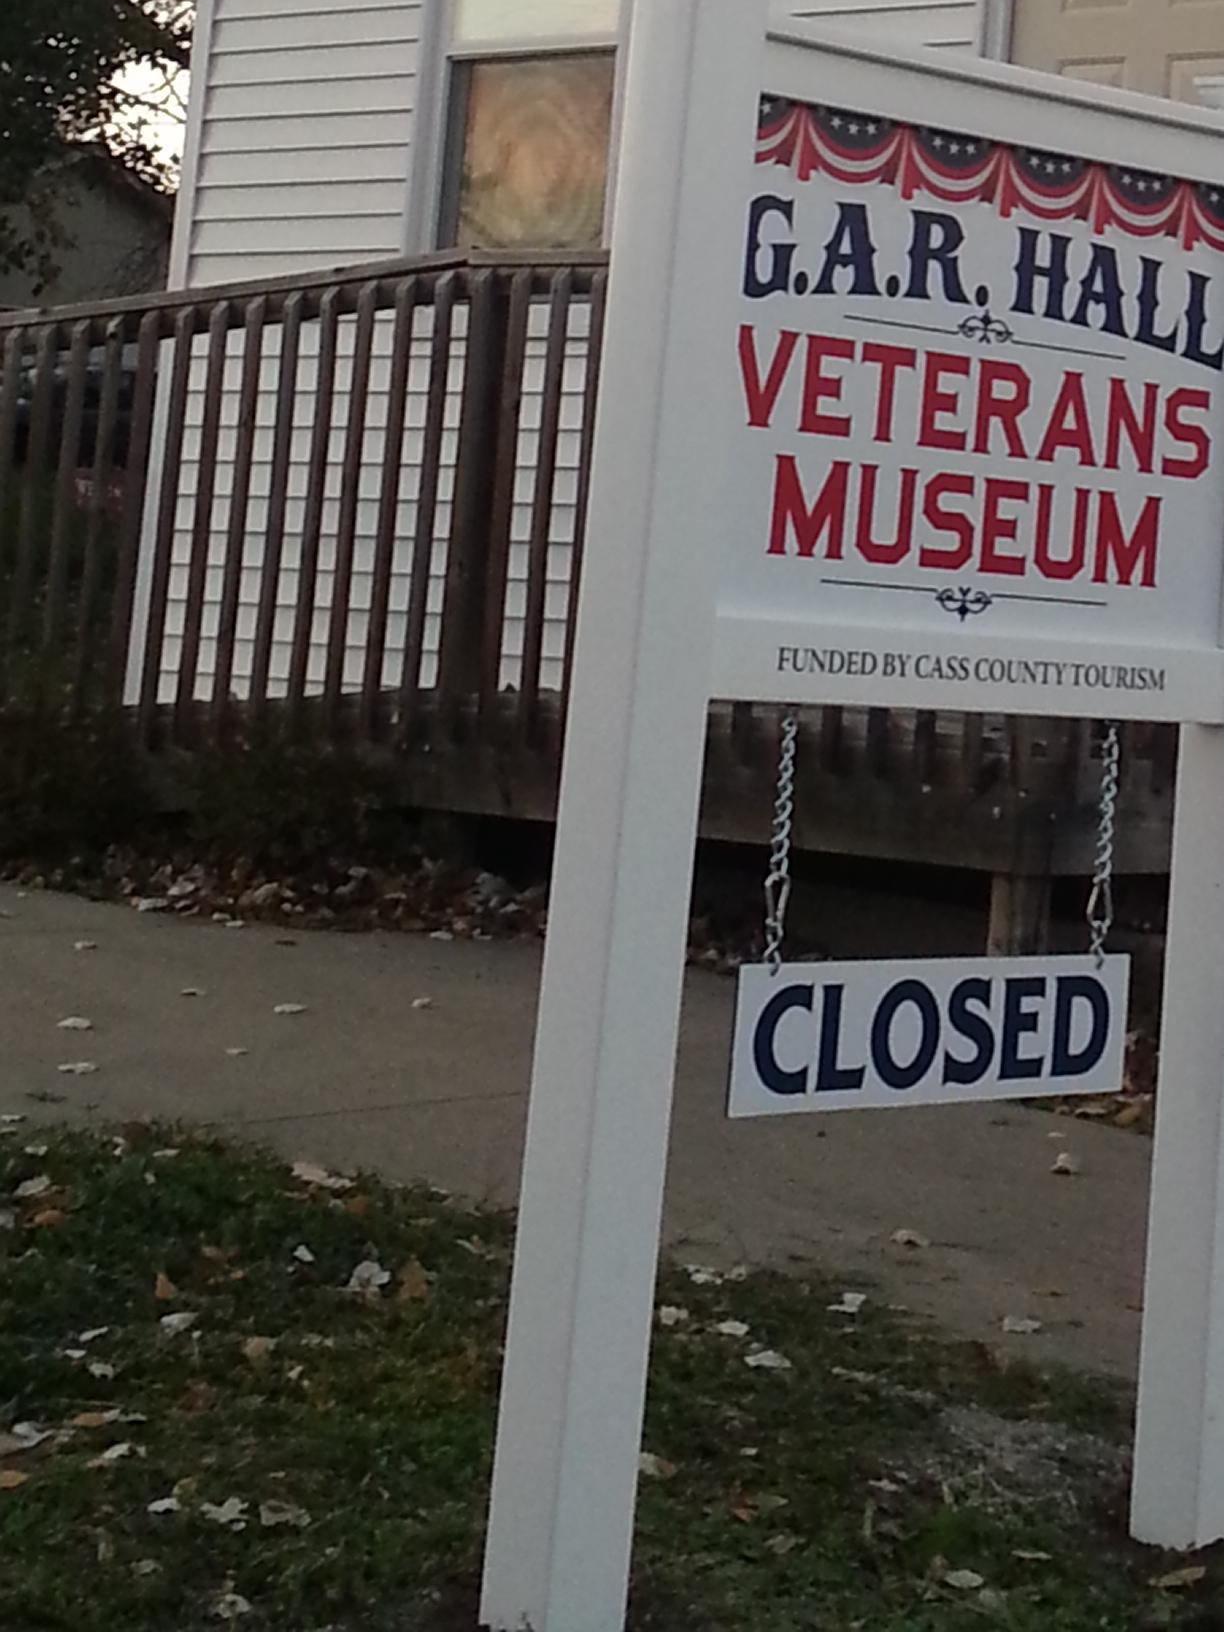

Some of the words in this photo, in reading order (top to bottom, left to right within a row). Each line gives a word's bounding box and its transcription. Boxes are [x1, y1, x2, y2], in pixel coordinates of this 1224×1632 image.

[743, 194, 989, 308] G.A.R.
[738, 324, 1212, 480] VETERANS
[766, 453, 1163, 589] MUSEUM
[777, 646, 878, 676] FUNDED
[881, 653, 912, 678] BY
[914, 654, 970, 681] CASS
[973, 657, 1071, 685] COUNTY
[1069, 662, 1165, 691] TOURISM
[752, 974, 1110, 1095] CLOSED
